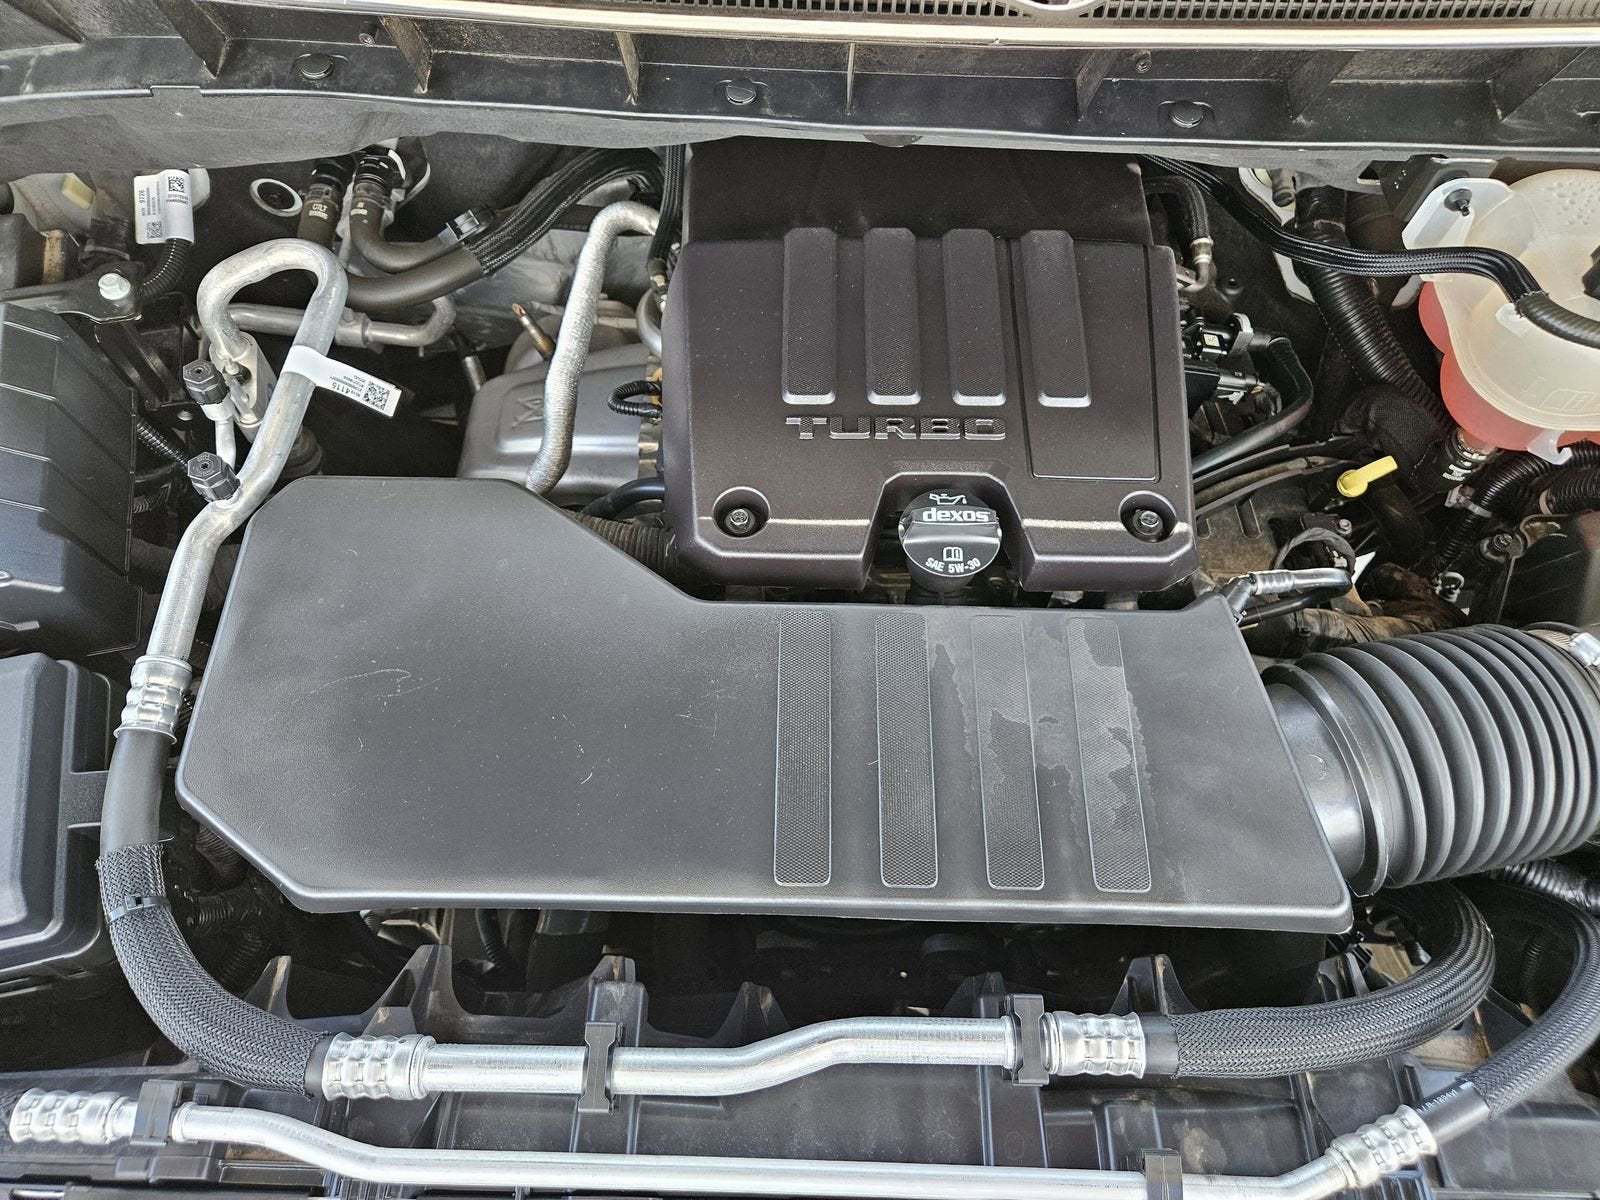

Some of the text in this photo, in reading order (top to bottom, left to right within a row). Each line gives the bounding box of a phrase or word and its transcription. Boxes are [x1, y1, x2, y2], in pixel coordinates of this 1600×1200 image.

[331, 382, 350, 394] 4115
[785, 416, 1006, 440] TURBO
[922, 508, 989, 522] dexos
[925, 557, 981, 574] SAE 5W-30
